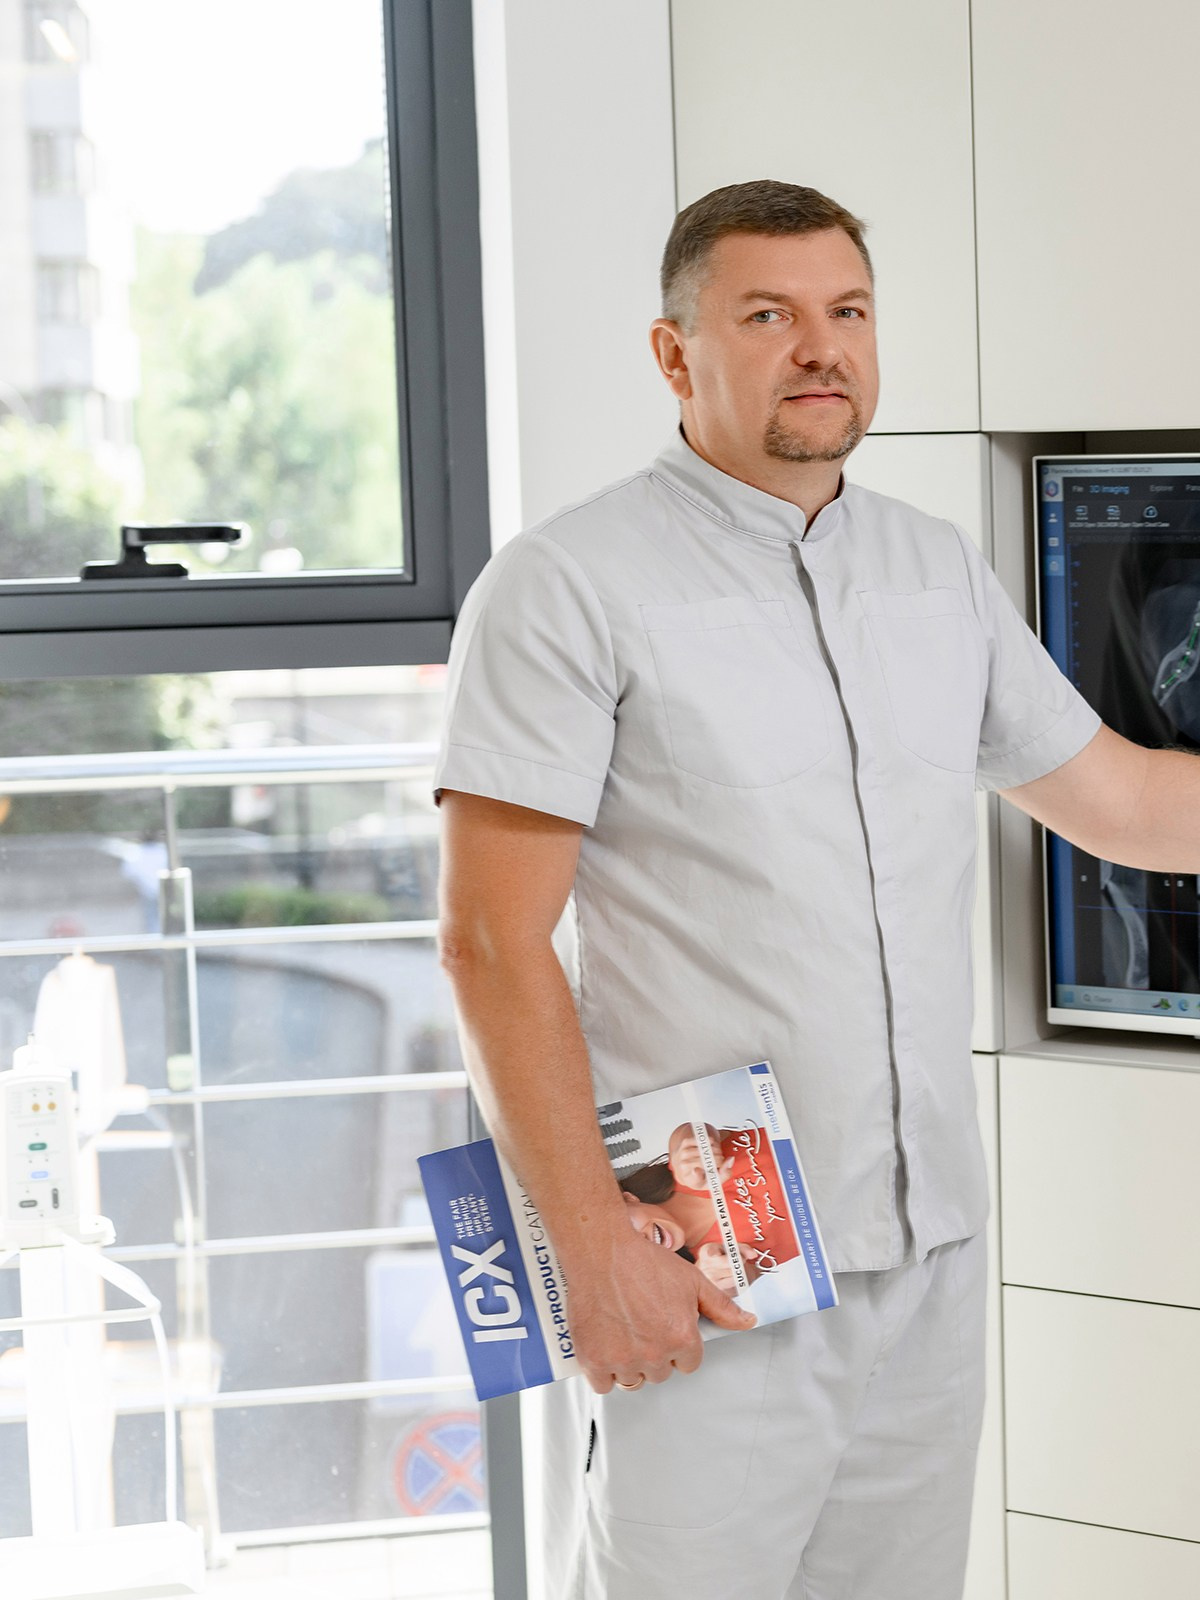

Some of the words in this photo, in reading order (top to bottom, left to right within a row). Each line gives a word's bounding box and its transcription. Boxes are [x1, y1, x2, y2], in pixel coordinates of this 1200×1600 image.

[1089, 485, 1100, 493] 3D
[1102, 485, 1130, 494] Imaging
[758, 1082, 780, 1134] medentis
[695, 1124, 723, 1198] IMPLANTATION!
[791, 1182, 800, 1194] BE
[449, 1199, 462, 1221] FAIR
[458, 1196, 476, 1237] PREMIUM
[716, 1198, 728, 1221] FAIR
[734, 1177, 765, 1242] makes
[454, 1222, 467, 1239] THE
[804, 1227, 813, 1239] BE
[722, 1229, 747, 1289] SUCCESSFUL
[814, 1268, 823, 1280] BE
[450, 1239, 529, 1343] ICX
